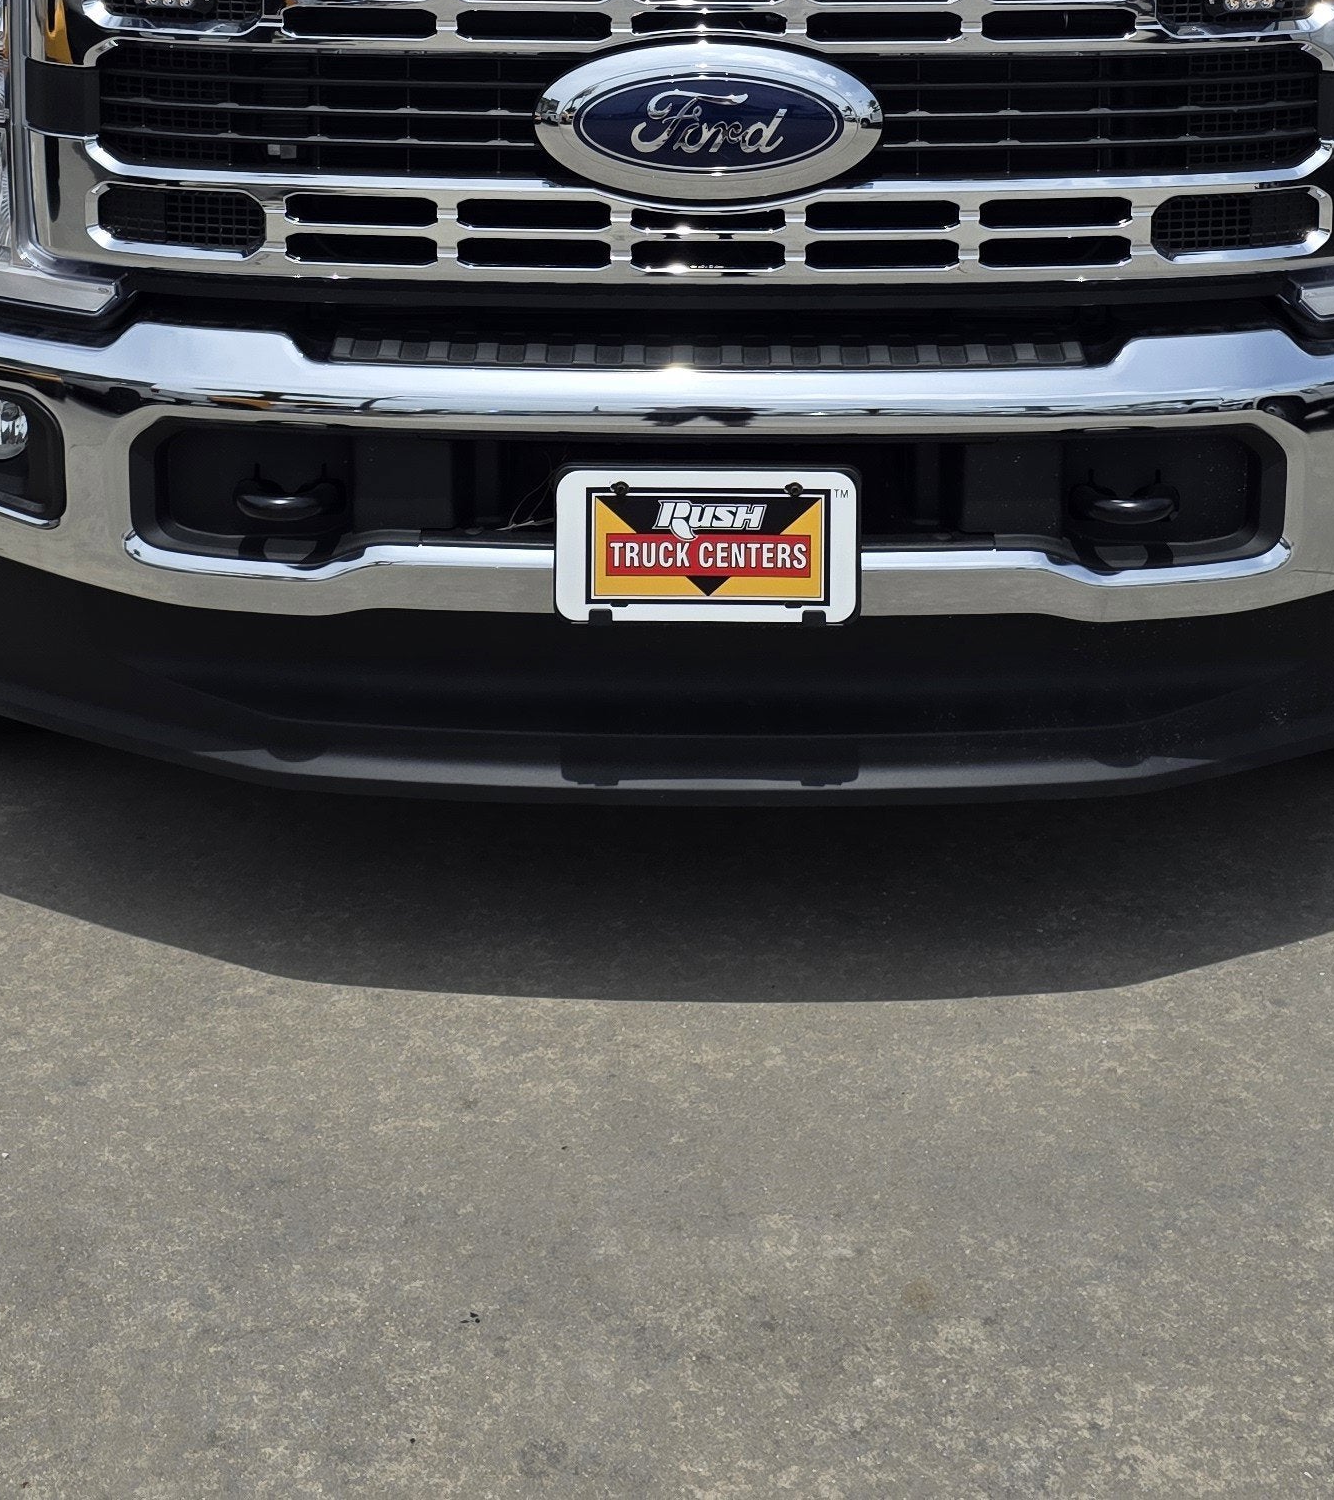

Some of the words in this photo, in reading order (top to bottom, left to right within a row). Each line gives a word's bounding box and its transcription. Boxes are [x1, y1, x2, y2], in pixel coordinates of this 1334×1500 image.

[630, 88, 788, 154] Ford
[609, 541, 691, 569] TRUCK
[698, 541, 808, 570] CENTERS
